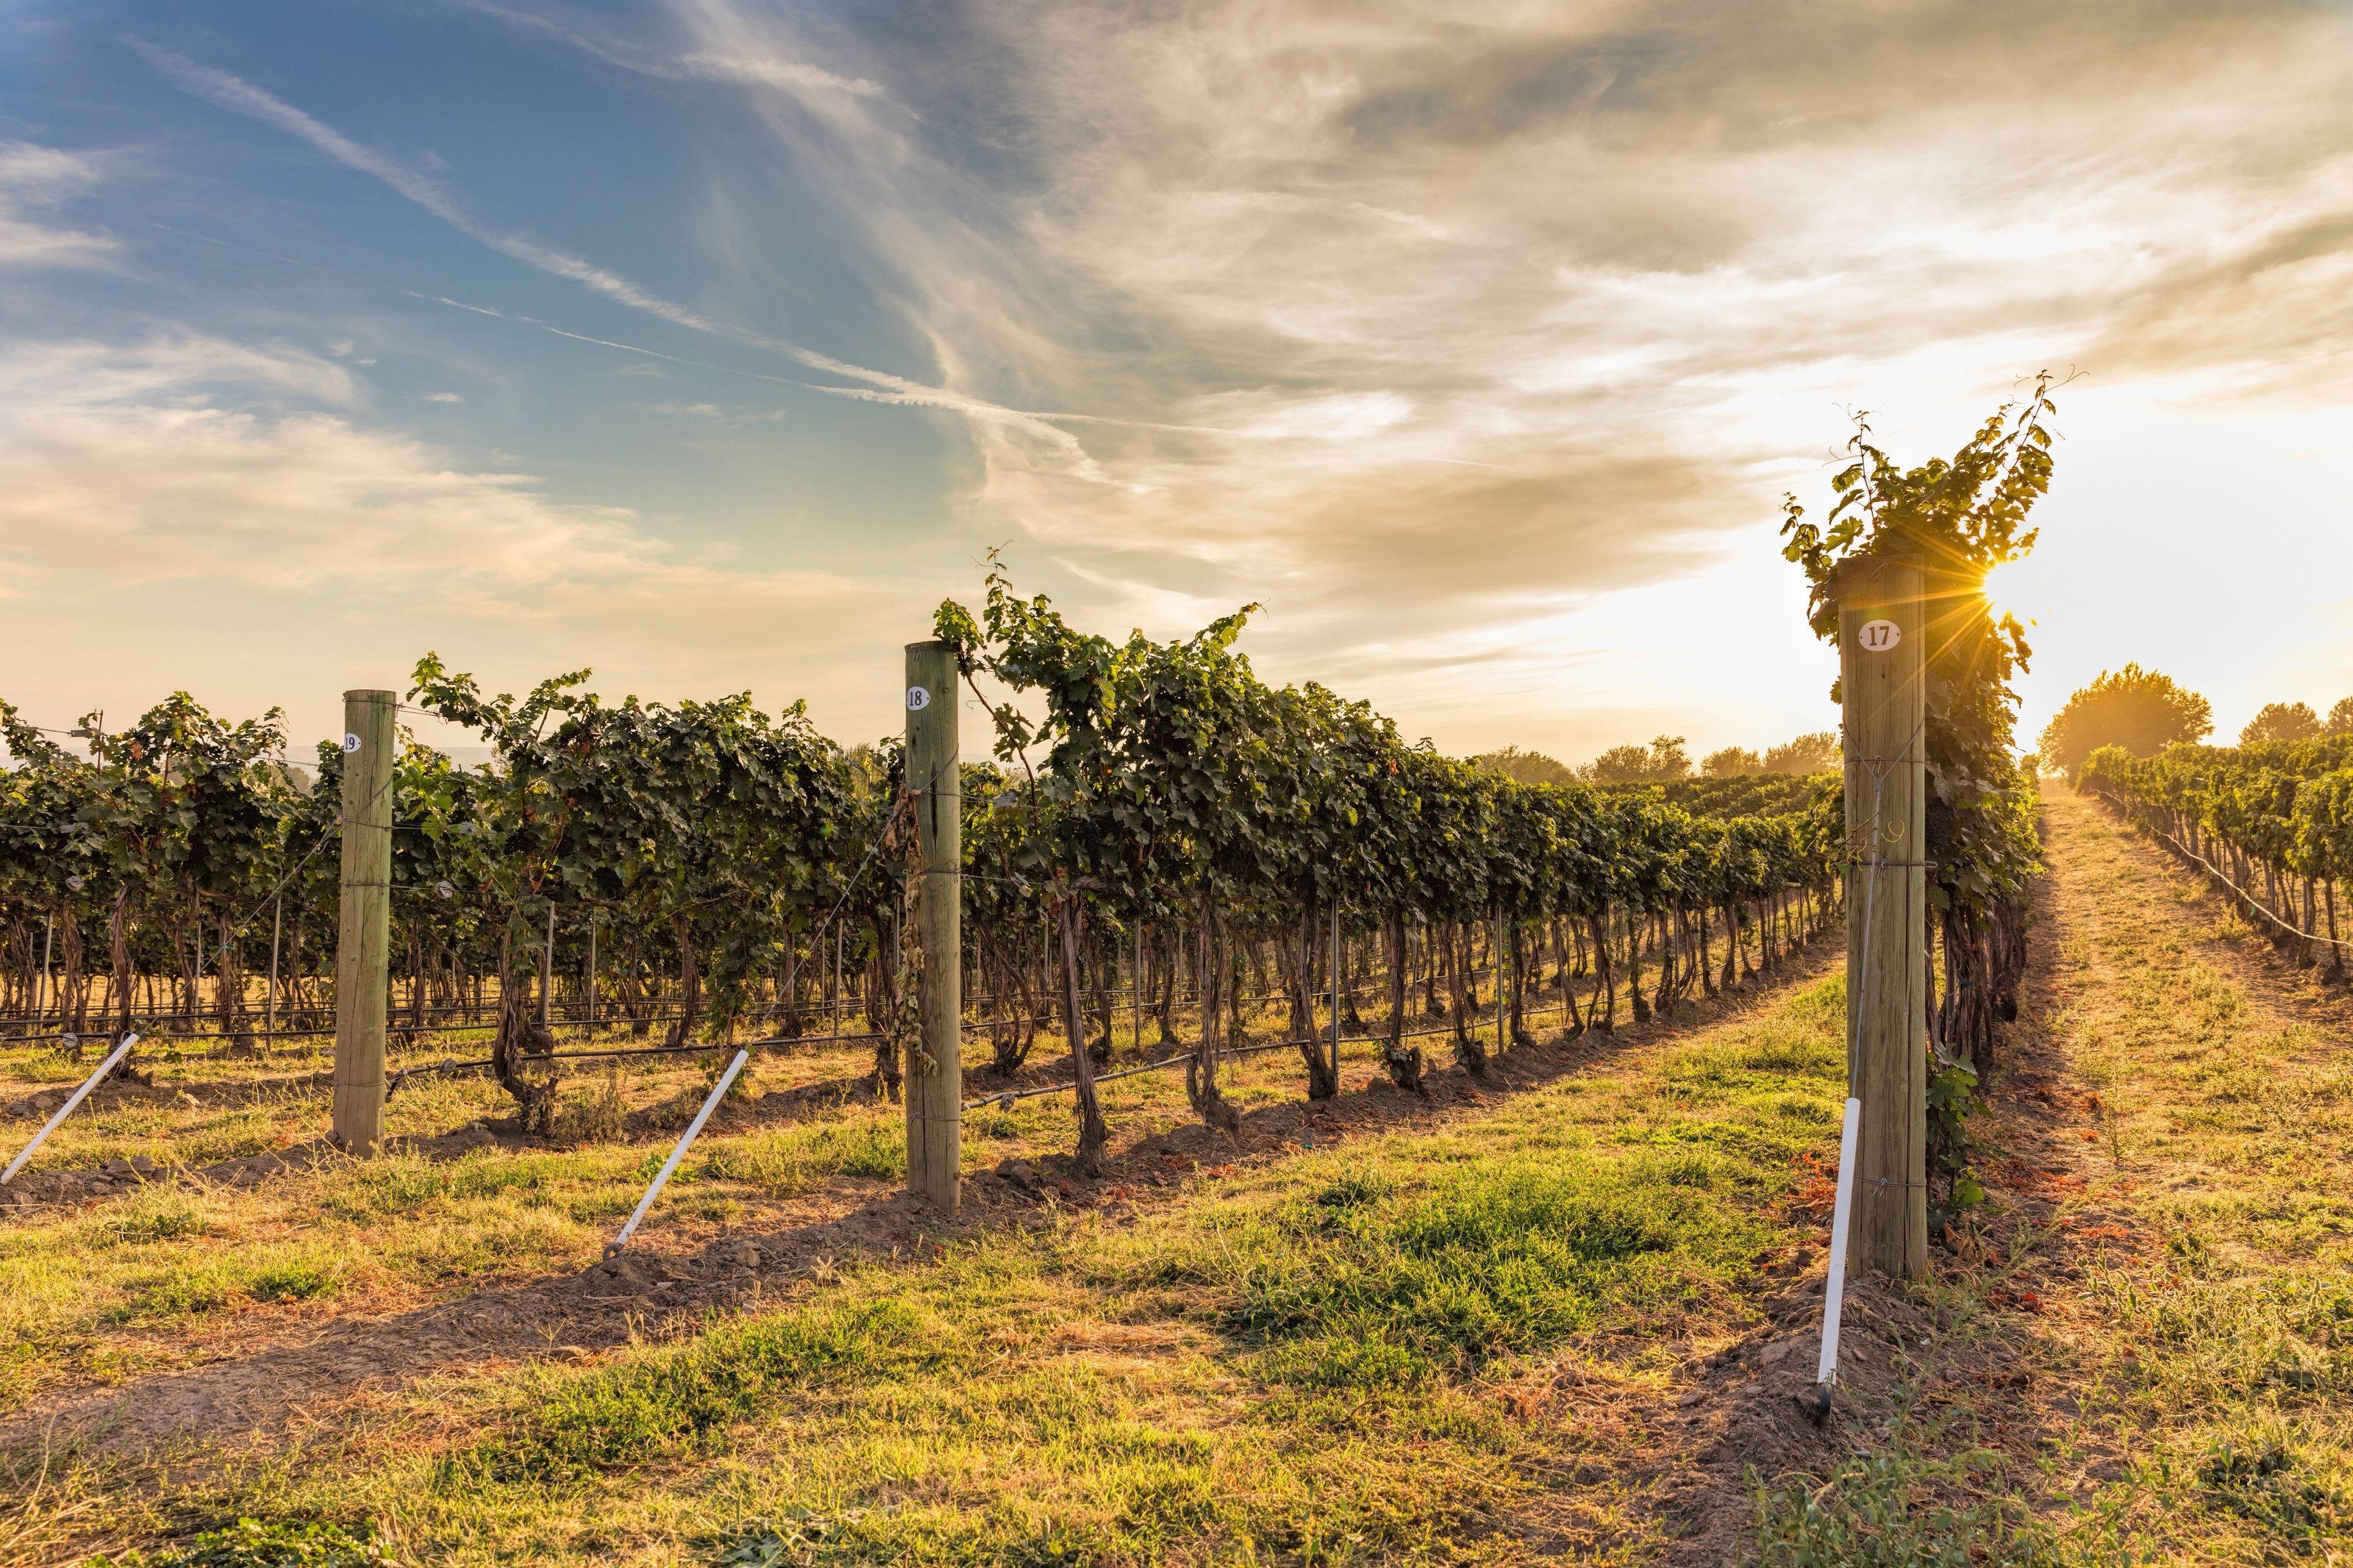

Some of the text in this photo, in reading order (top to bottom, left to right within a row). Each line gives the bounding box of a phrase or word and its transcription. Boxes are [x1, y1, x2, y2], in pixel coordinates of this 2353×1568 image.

[1869, 626, 1890, 645] 17
[910, 691, 922, 706] 18
[345, 737, 355, 749] 19
